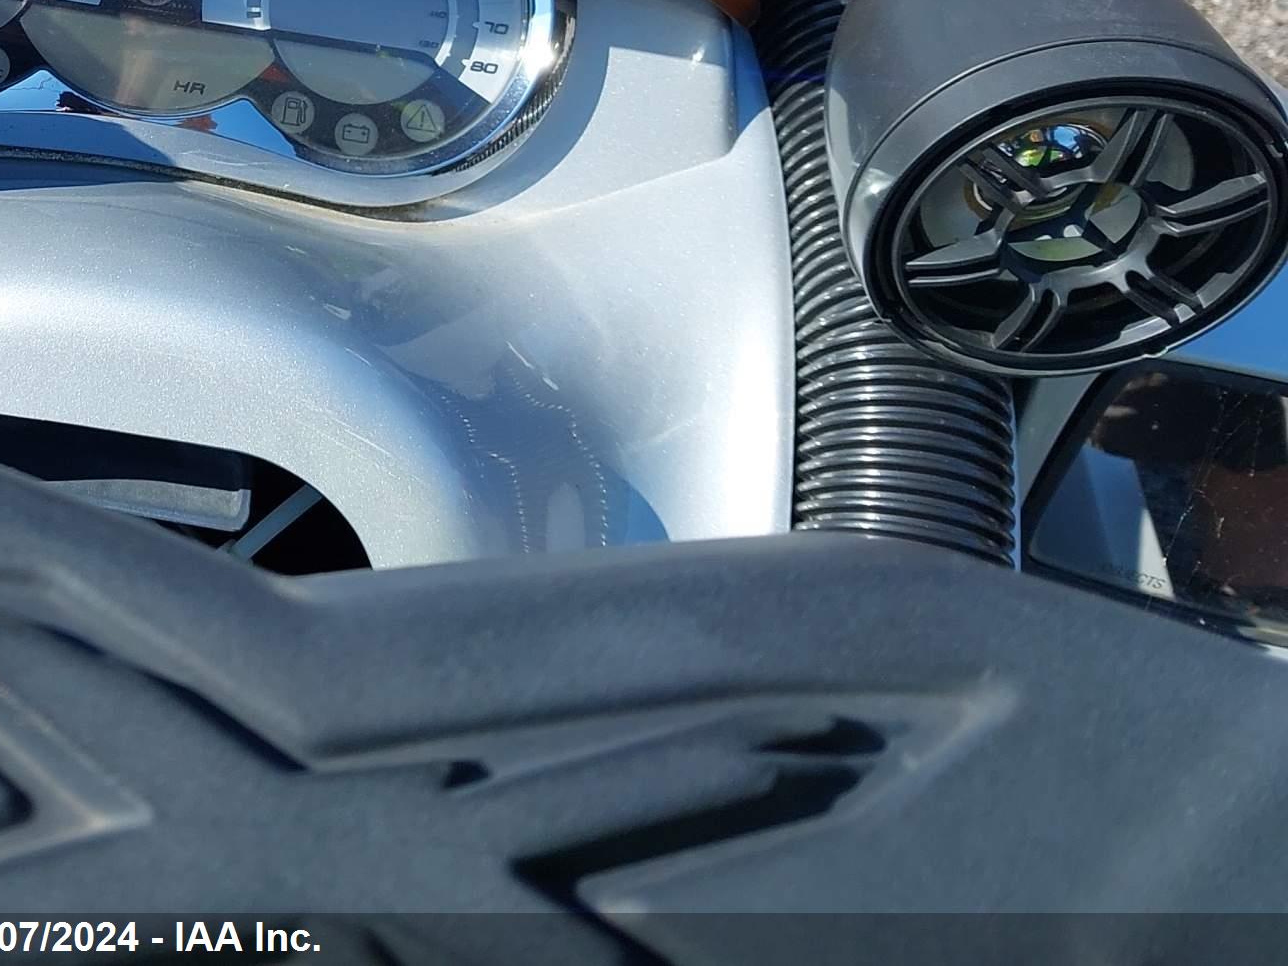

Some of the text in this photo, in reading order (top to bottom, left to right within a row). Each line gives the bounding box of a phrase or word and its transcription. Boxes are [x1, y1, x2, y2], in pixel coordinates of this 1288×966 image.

[484, 21, 509, 35] 70
[470, 61, 499, 75] 80
[174, 80, 206, 96] HR
